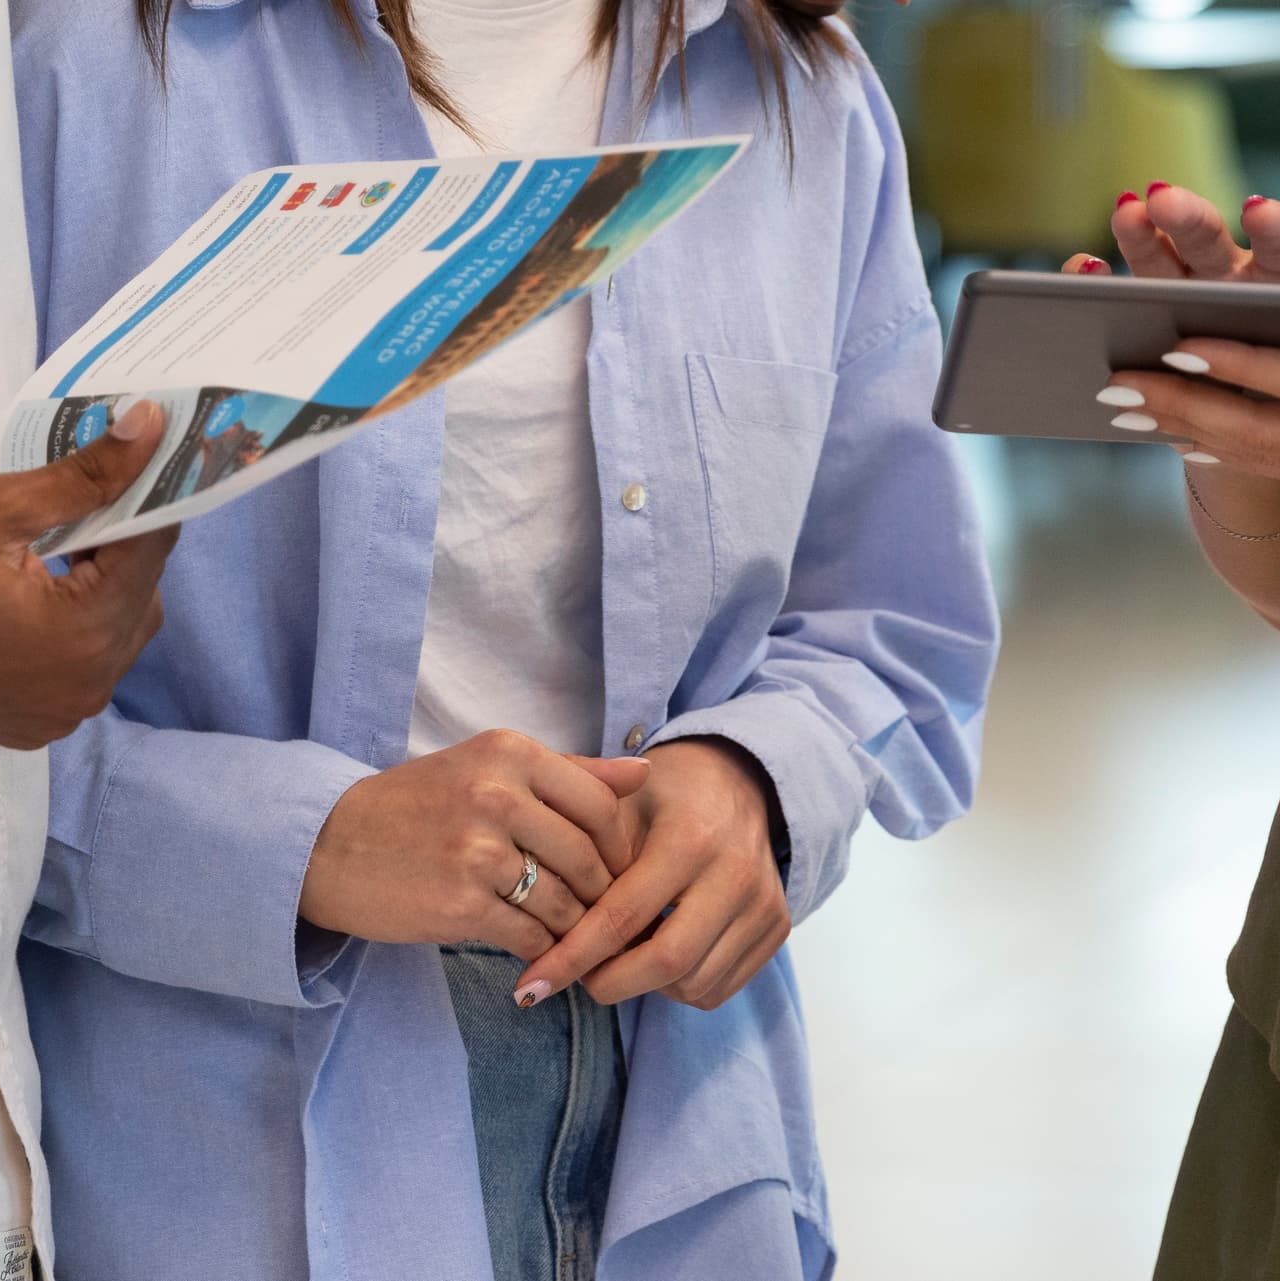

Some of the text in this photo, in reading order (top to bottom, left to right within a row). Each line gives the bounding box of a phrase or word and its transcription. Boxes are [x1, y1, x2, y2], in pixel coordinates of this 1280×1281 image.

[377, 168, 561, 363] AROUND THE WORLD
[404, 167, 582, 356] LET'S GO TRAVELING
